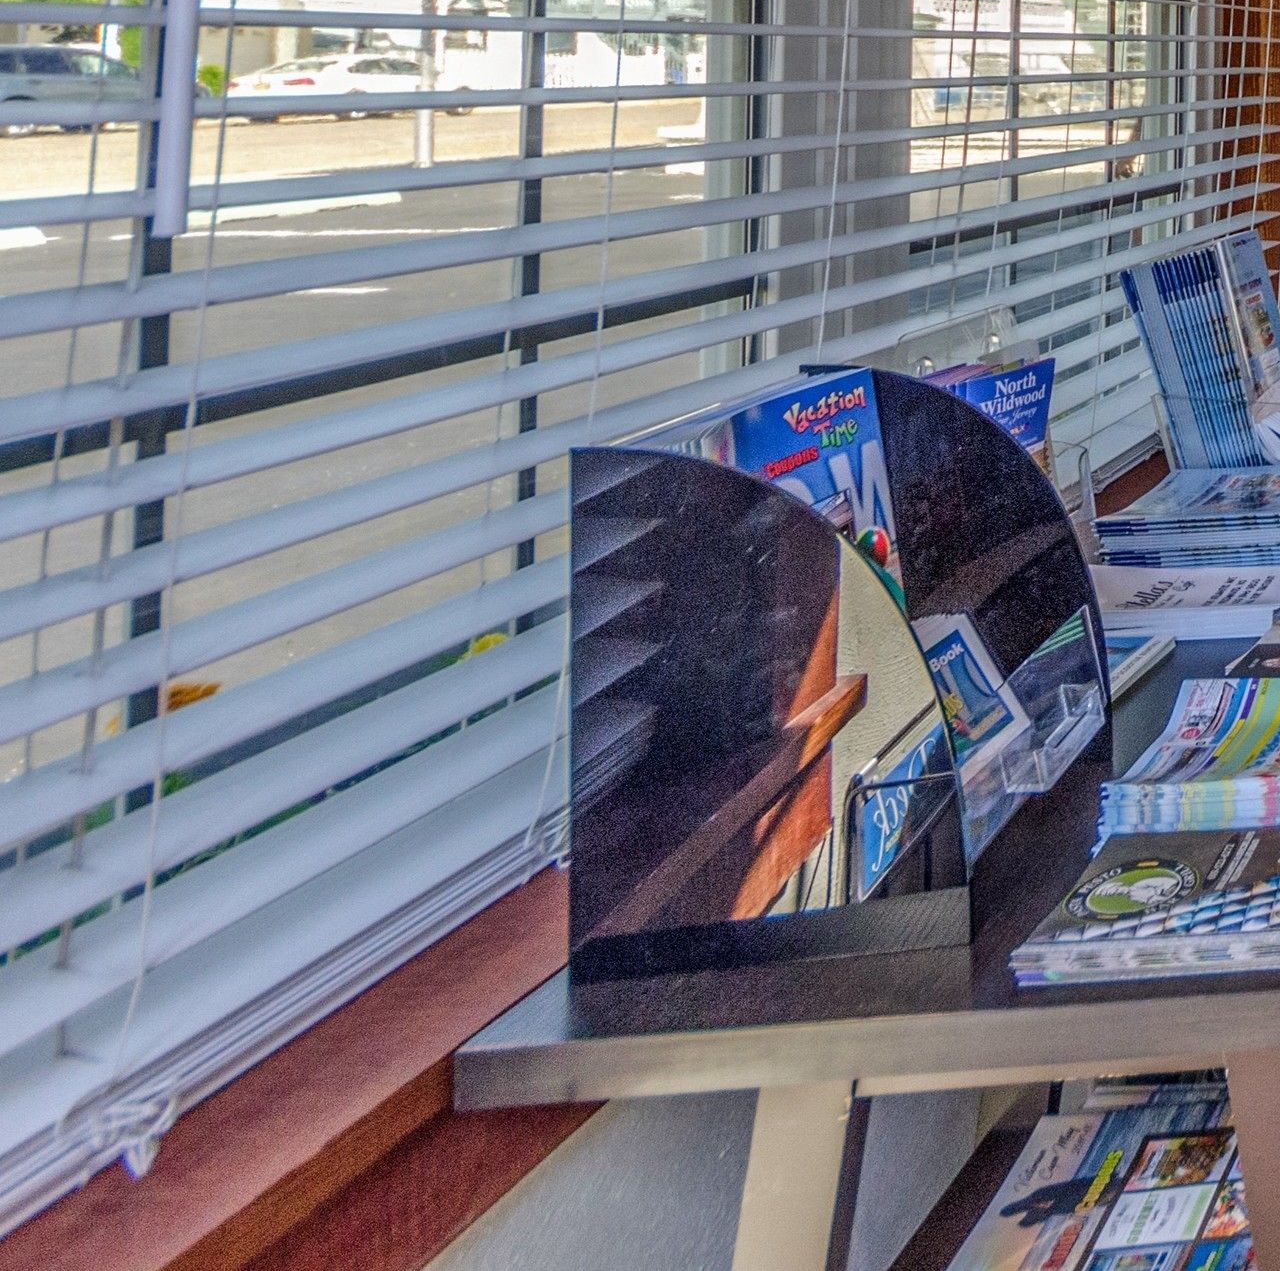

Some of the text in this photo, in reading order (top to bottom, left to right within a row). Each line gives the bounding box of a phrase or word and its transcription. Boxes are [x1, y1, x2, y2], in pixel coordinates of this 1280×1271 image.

[980, 384, 1046, 415] Wildwood
[995, 371, 1036, 398] North
[783, 386, 867, 434] Vacation
[812, 418, 858, 448] Time
[928, 642, 965, 673] Book
